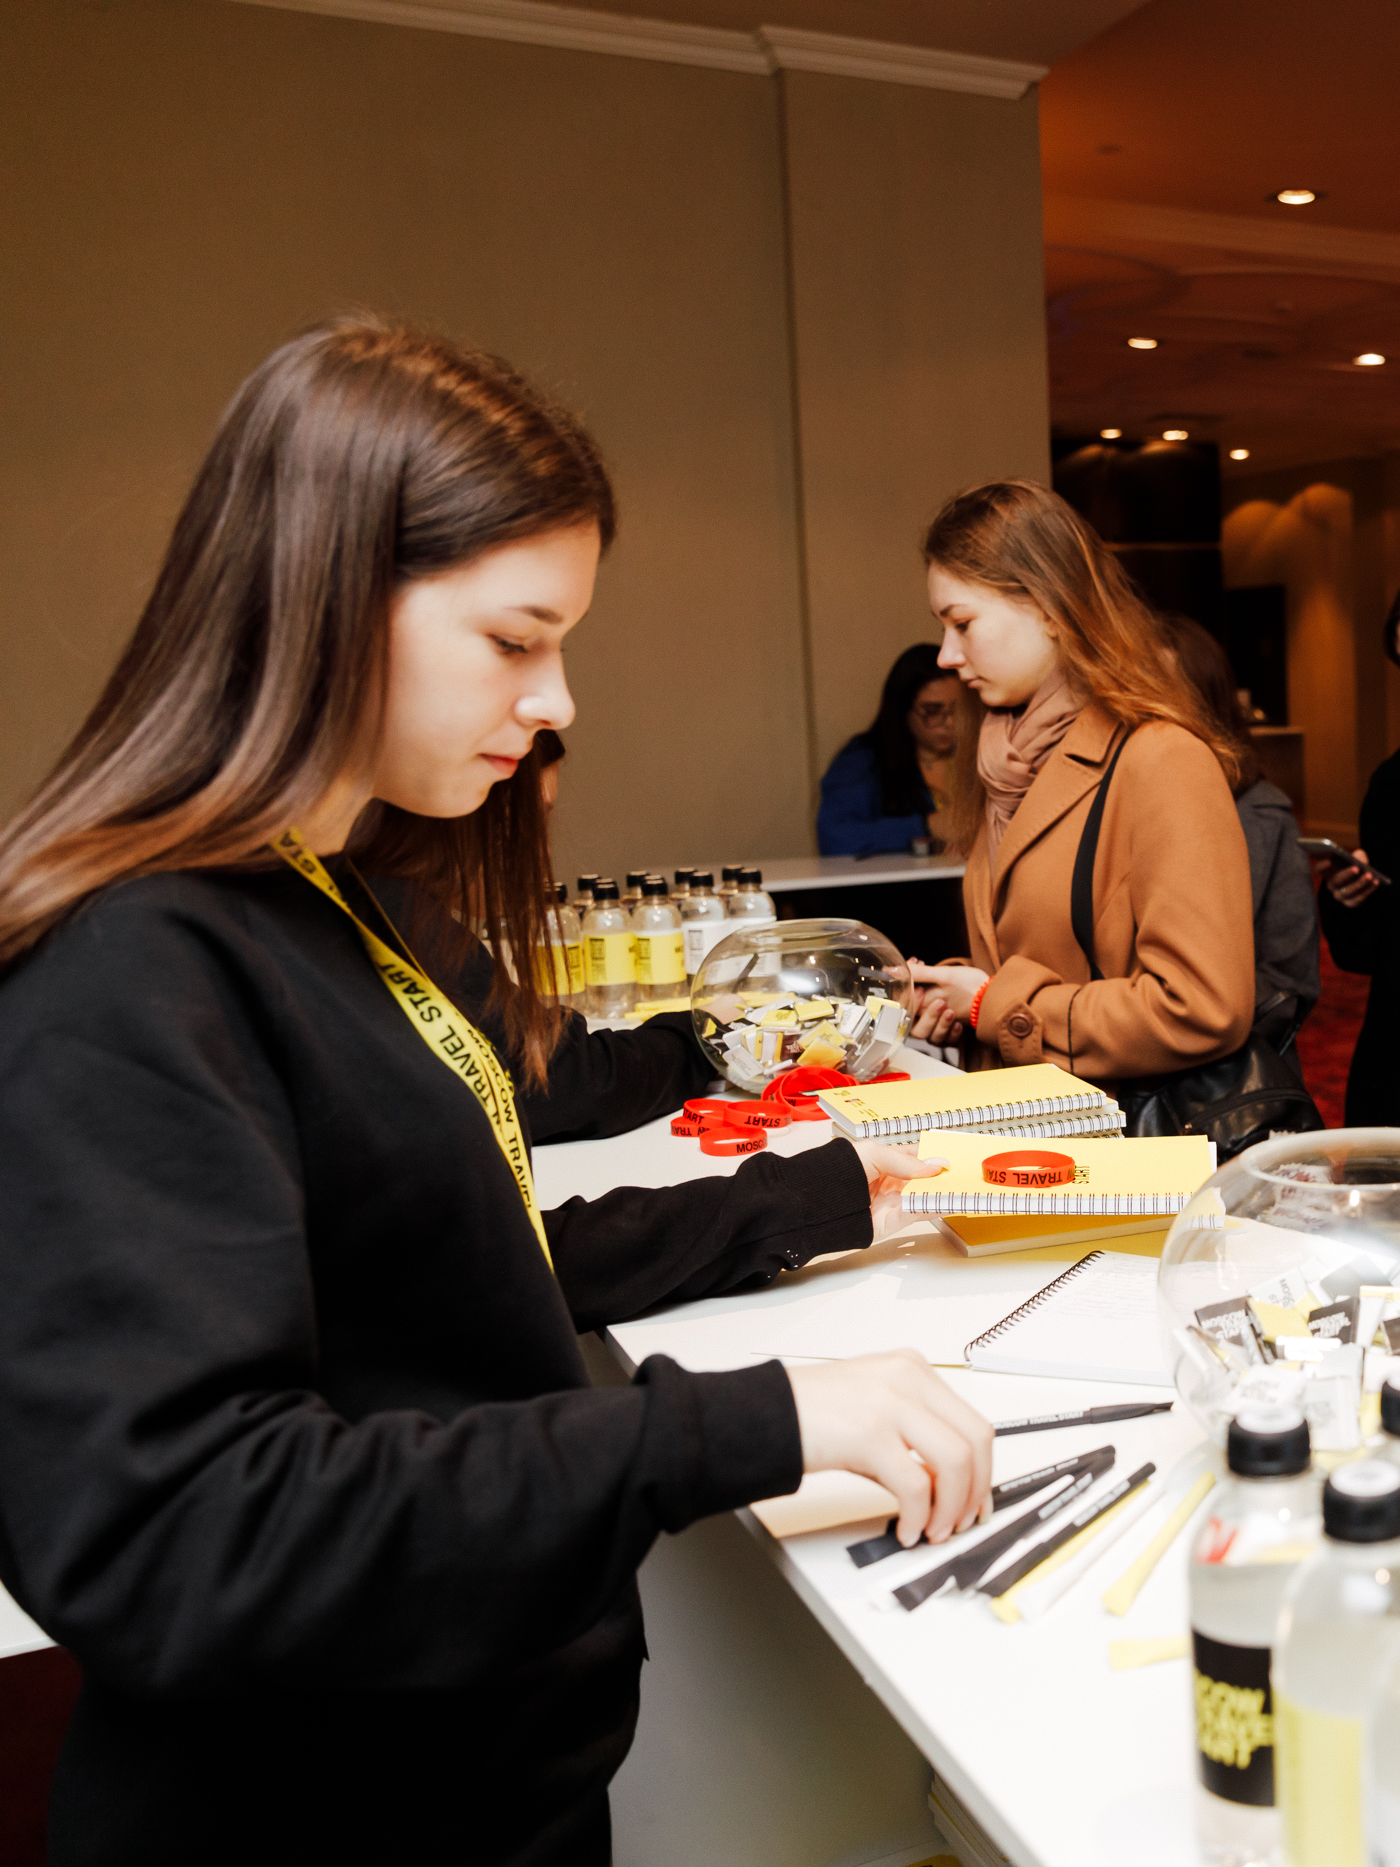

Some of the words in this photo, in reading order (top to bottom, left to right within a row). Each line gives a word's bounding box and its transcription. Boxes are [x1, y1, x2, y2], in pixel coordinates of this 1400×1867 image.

[379, 963, 443, 1023] START
[439, 1024, 492, 1107] TRAVEL
[467, 1028, 515, 1123] MOSCOW
[744, 1115, 781, 1128] START
[736, 1139, 767, 1154] MOSC
[1012, 1171, 1063, 1185] TRAVEL
